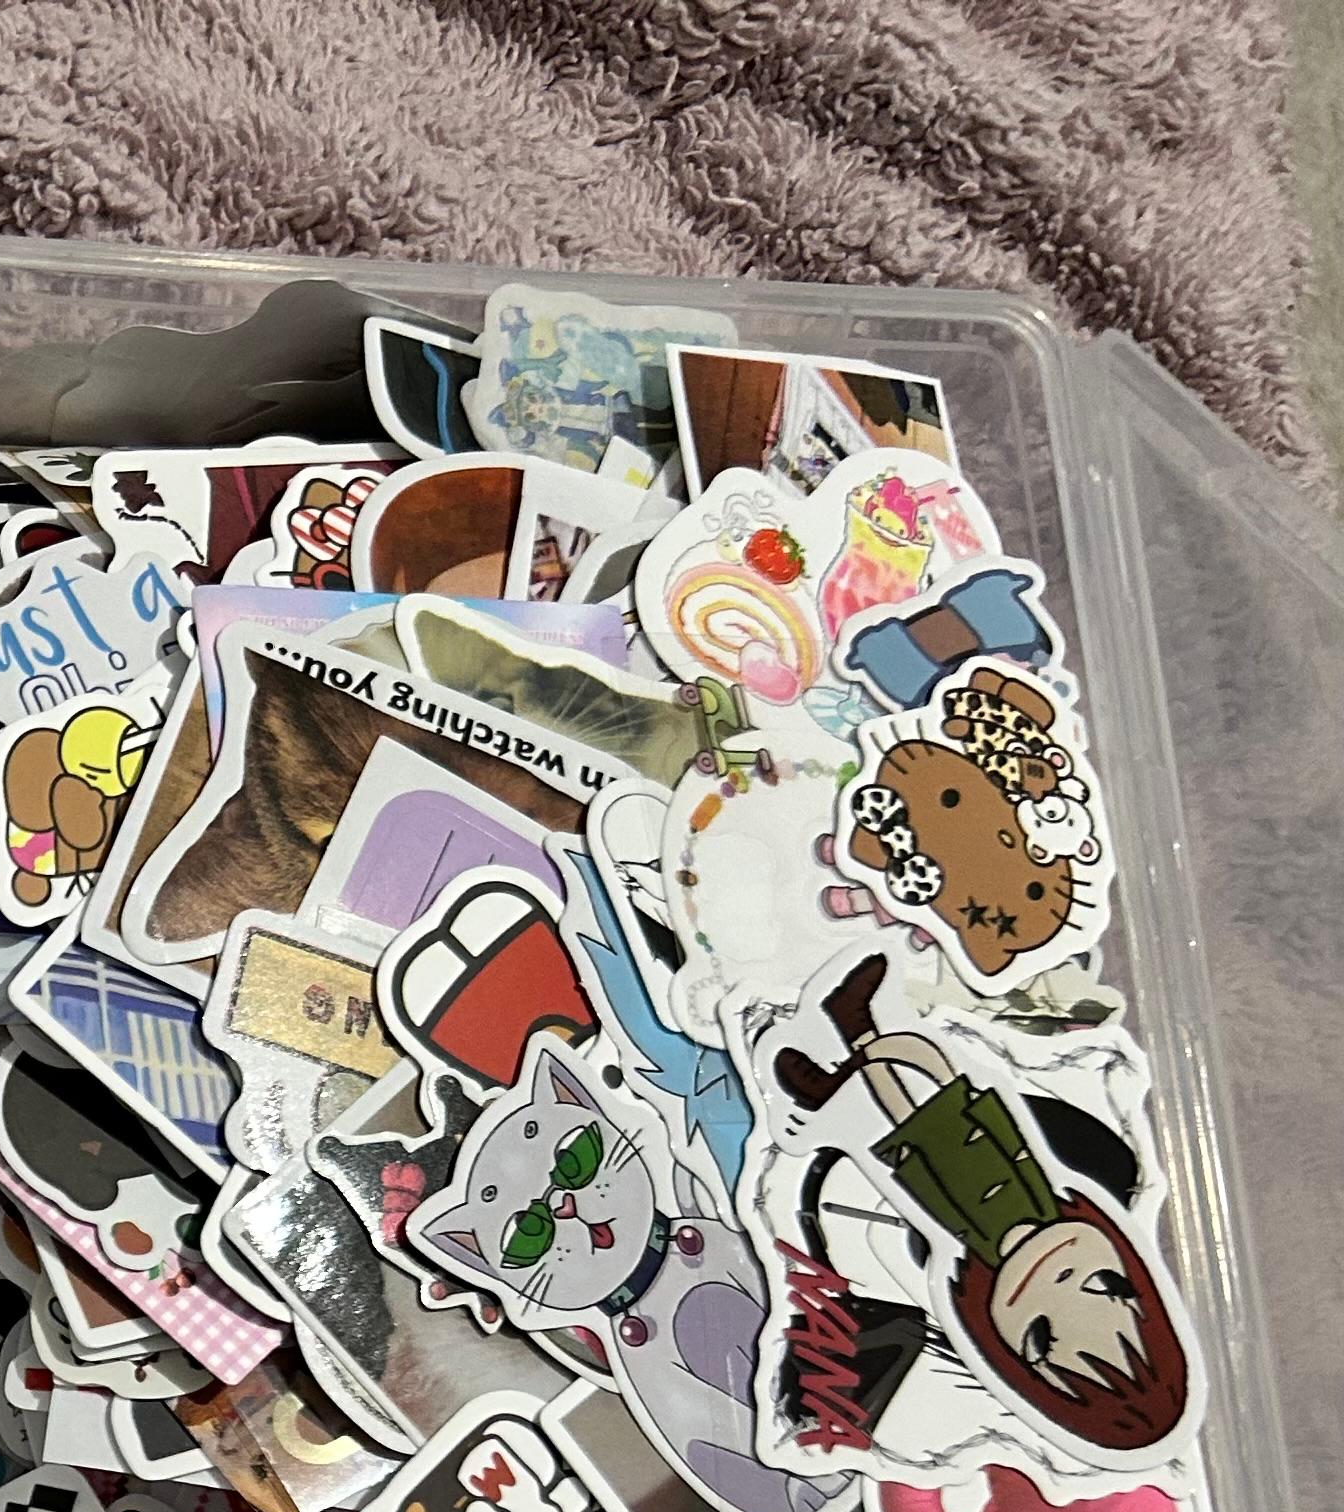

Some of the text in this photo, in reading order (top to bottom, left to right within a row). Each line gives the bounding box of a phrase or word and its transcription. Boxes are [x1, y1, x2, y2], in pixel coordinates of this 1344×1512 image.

[131, 561, 180, 624] a
[387, 680, 566, 778] watching
[773, 1237, 874, 1454] NANA
